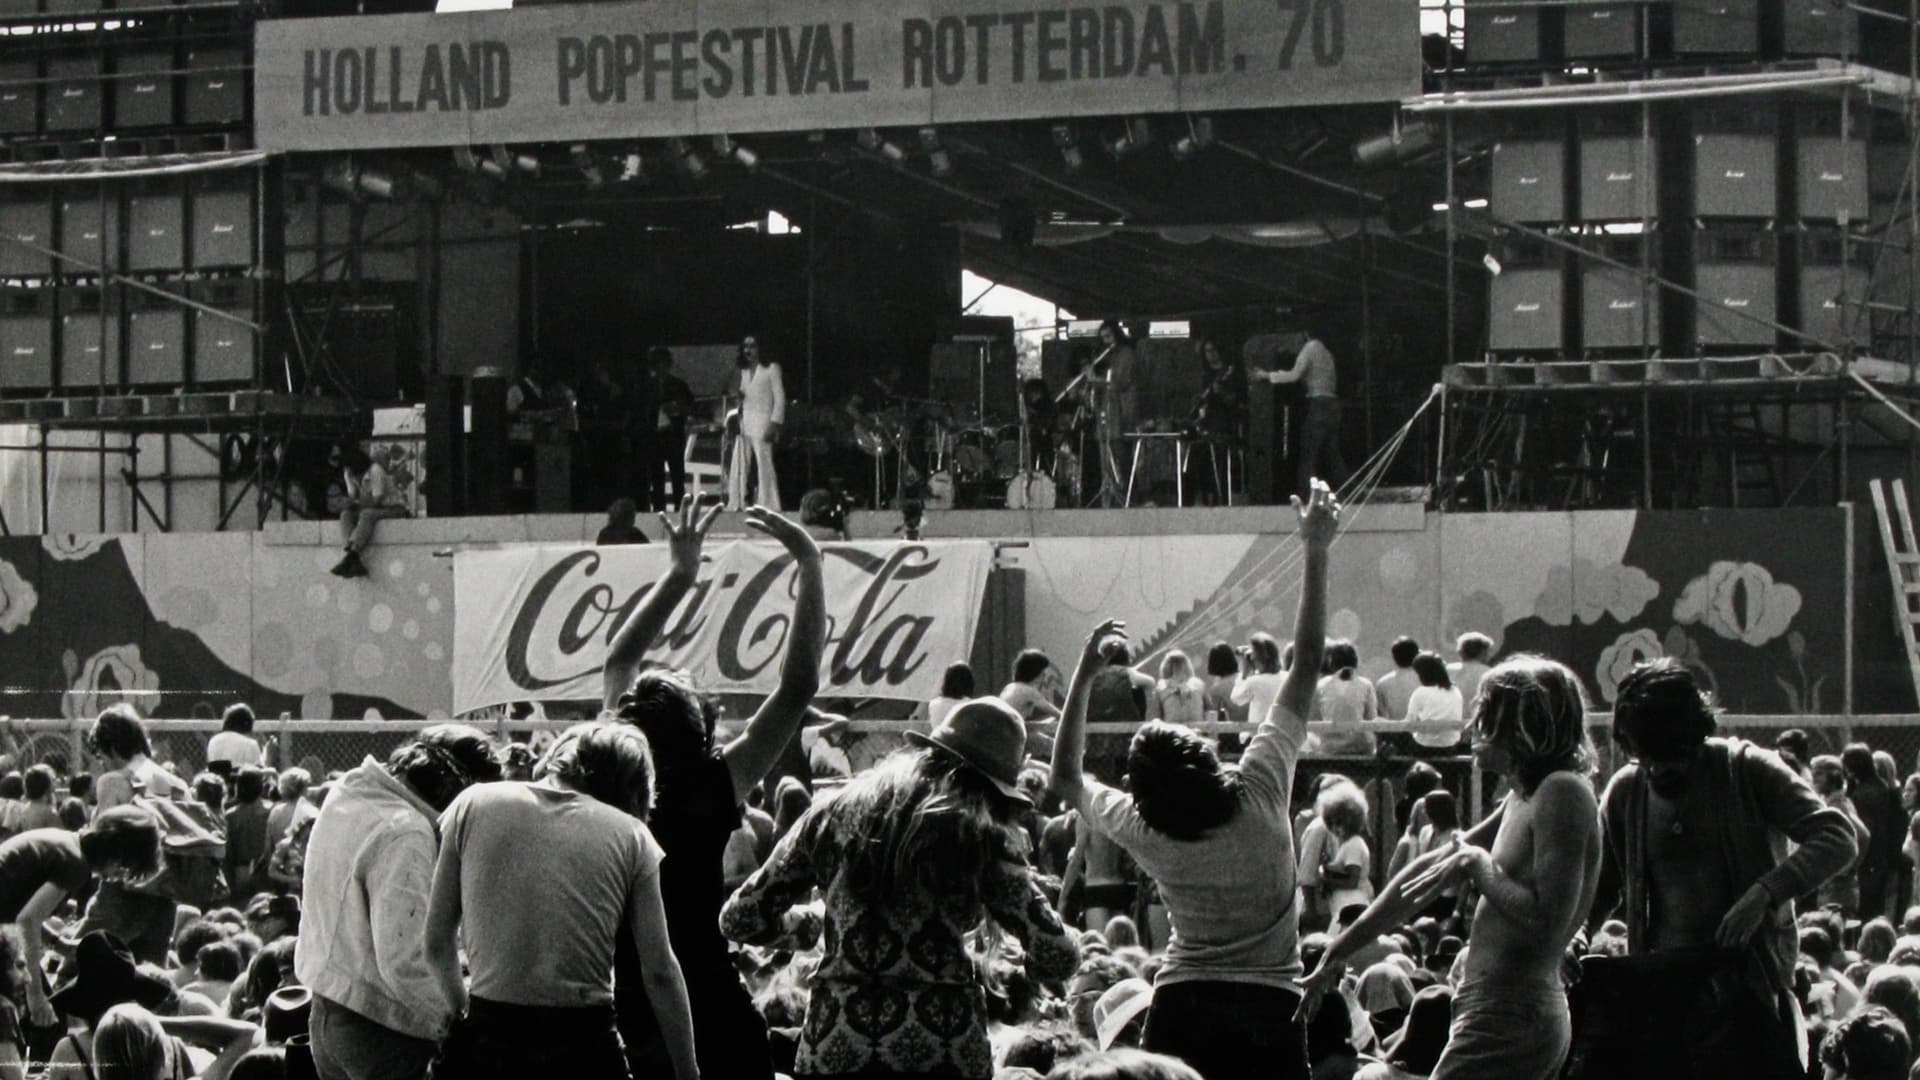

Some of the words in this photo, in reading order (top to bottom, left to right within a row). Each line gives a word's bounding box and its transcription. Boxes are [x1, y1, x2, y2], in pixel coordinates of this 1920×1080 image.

[303, 41, 511, 116] HOLLAND
[557, 22, 869, 105] POPFESTIVAL
[903, 1, 1246, 88] ROTTERDAM.
[1278, 0, 1345, 70] 70
[506, 546, 941, 690] Coca-Cla
